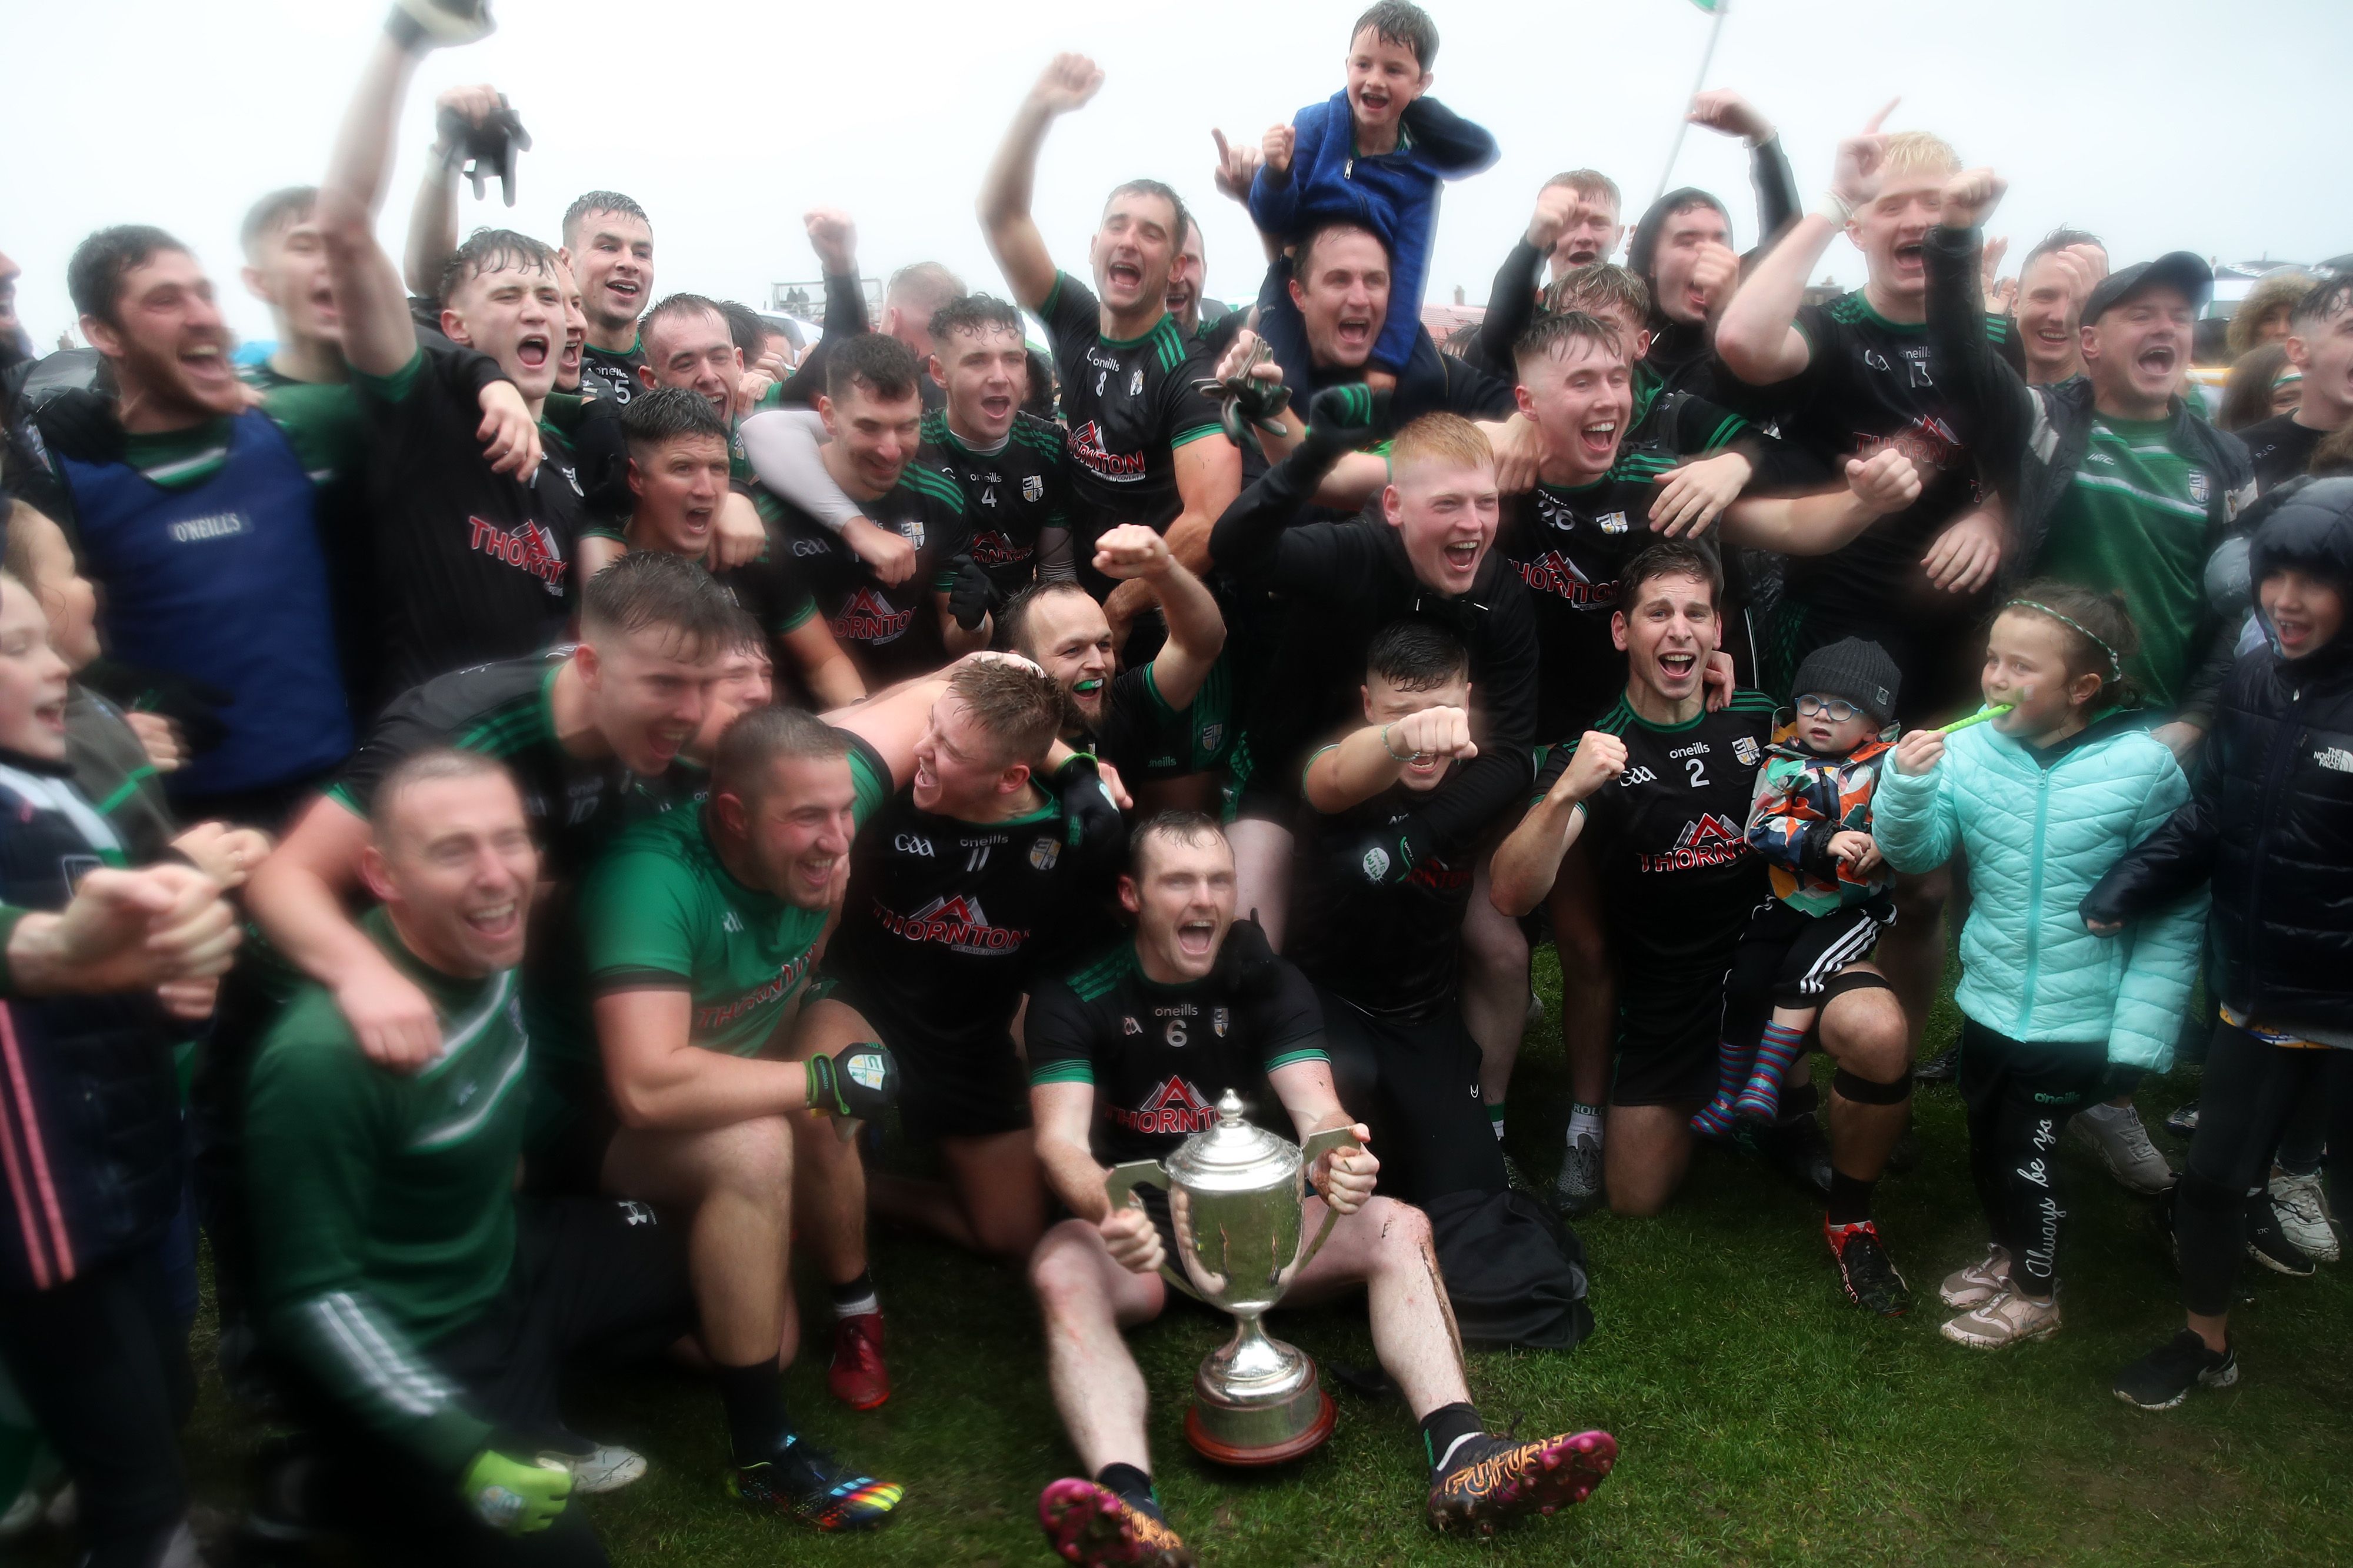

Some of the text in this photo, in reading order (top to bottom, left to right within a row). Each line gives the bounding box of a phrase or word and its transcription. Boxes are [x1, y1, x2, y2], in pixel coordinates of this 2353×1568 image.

[1095, 371, 1107, 397] 8
[1908, 361, 1933, 388] 13
[981, 485, 997, 508] 4
[1538, 500, 1576, 531] 26
[1686, 759, 1710, 788] 2
[966, 846, 991, 872] 11
[1166, 1019, 1188, 1047] 6
[1102, 1104, 1221, 1133] THORNT
[2017, 1158, 2049, 1187] be
[2025, 1197, 2067, 1277] Always
